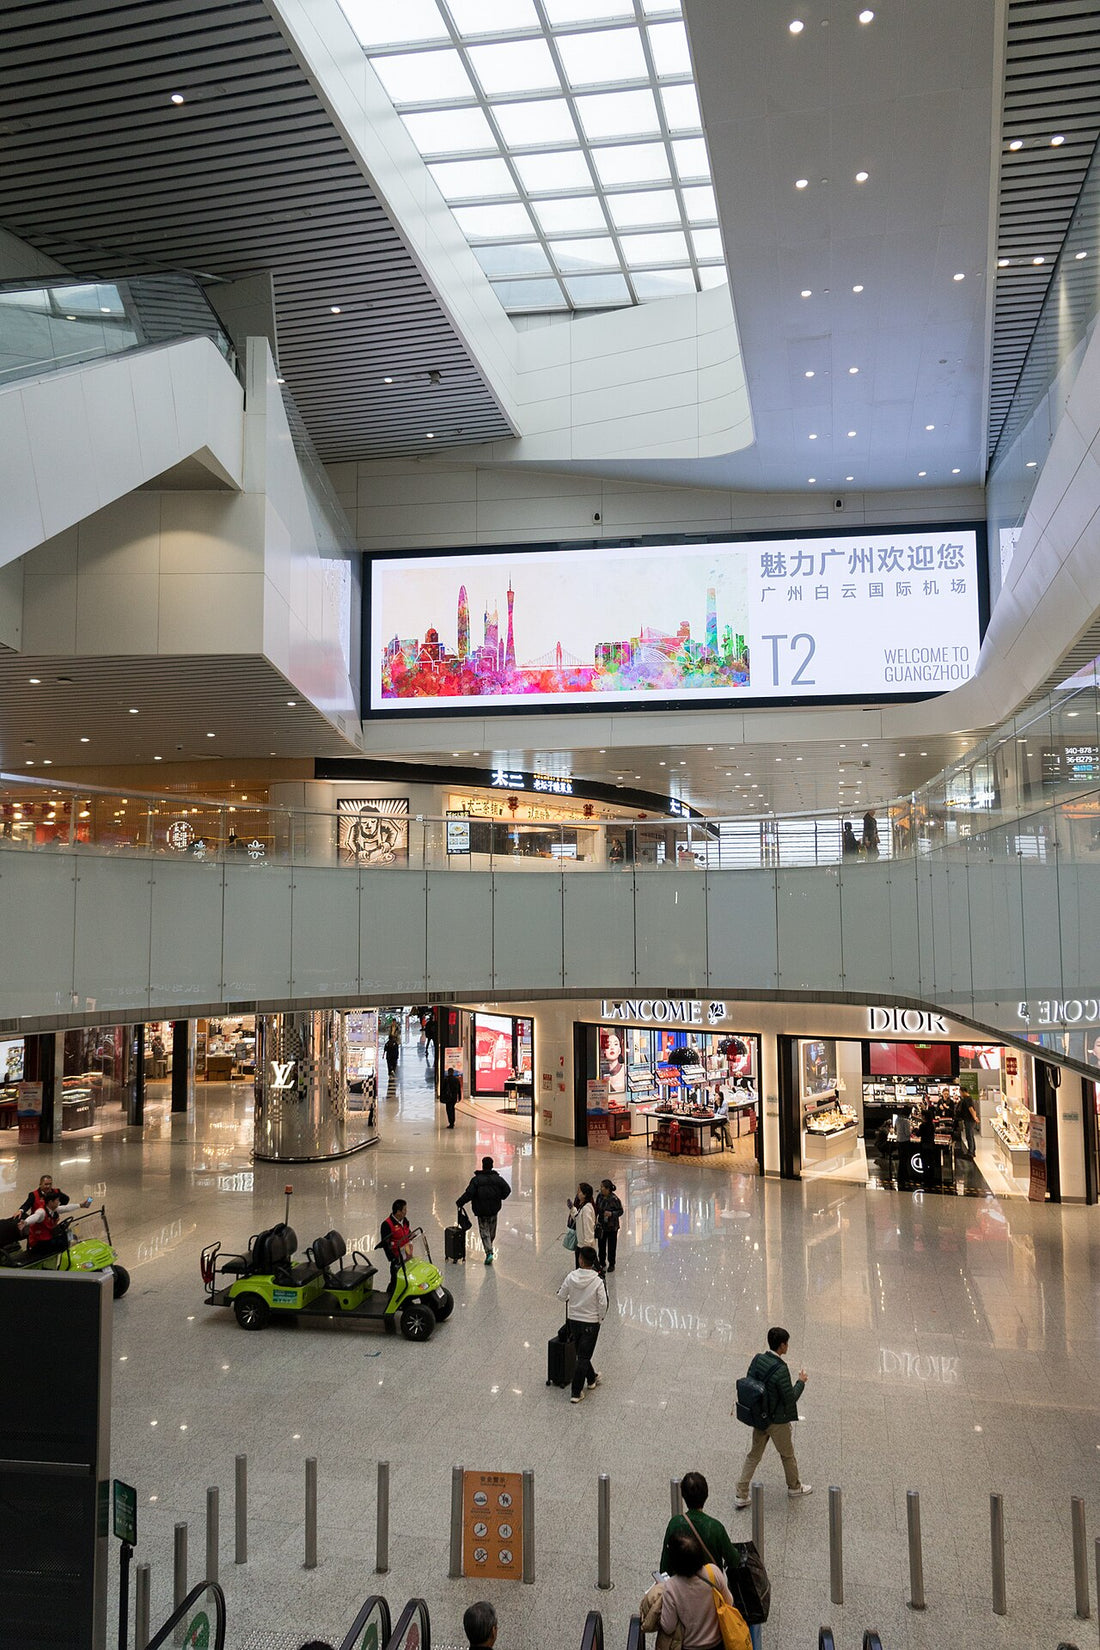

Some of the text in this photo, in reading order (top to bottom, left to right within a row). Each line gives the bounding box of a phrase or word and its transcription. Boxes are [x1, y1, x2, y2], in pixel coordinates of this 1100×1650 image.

[760, 543, 965, 578] 魅力广州欢迎您
[761, 579, 967, 602] 广州白云国际机场
[761, 633, 816, 687] T2
[884, 646, 969, 664] WELCOME TO
[884, 664, 970, 682] GUANGZHOU
[491, 769, 525, 788] 太二
[867, 1007, 948, 1033] DIOR
[270, 1060, 296, 1089] LV
